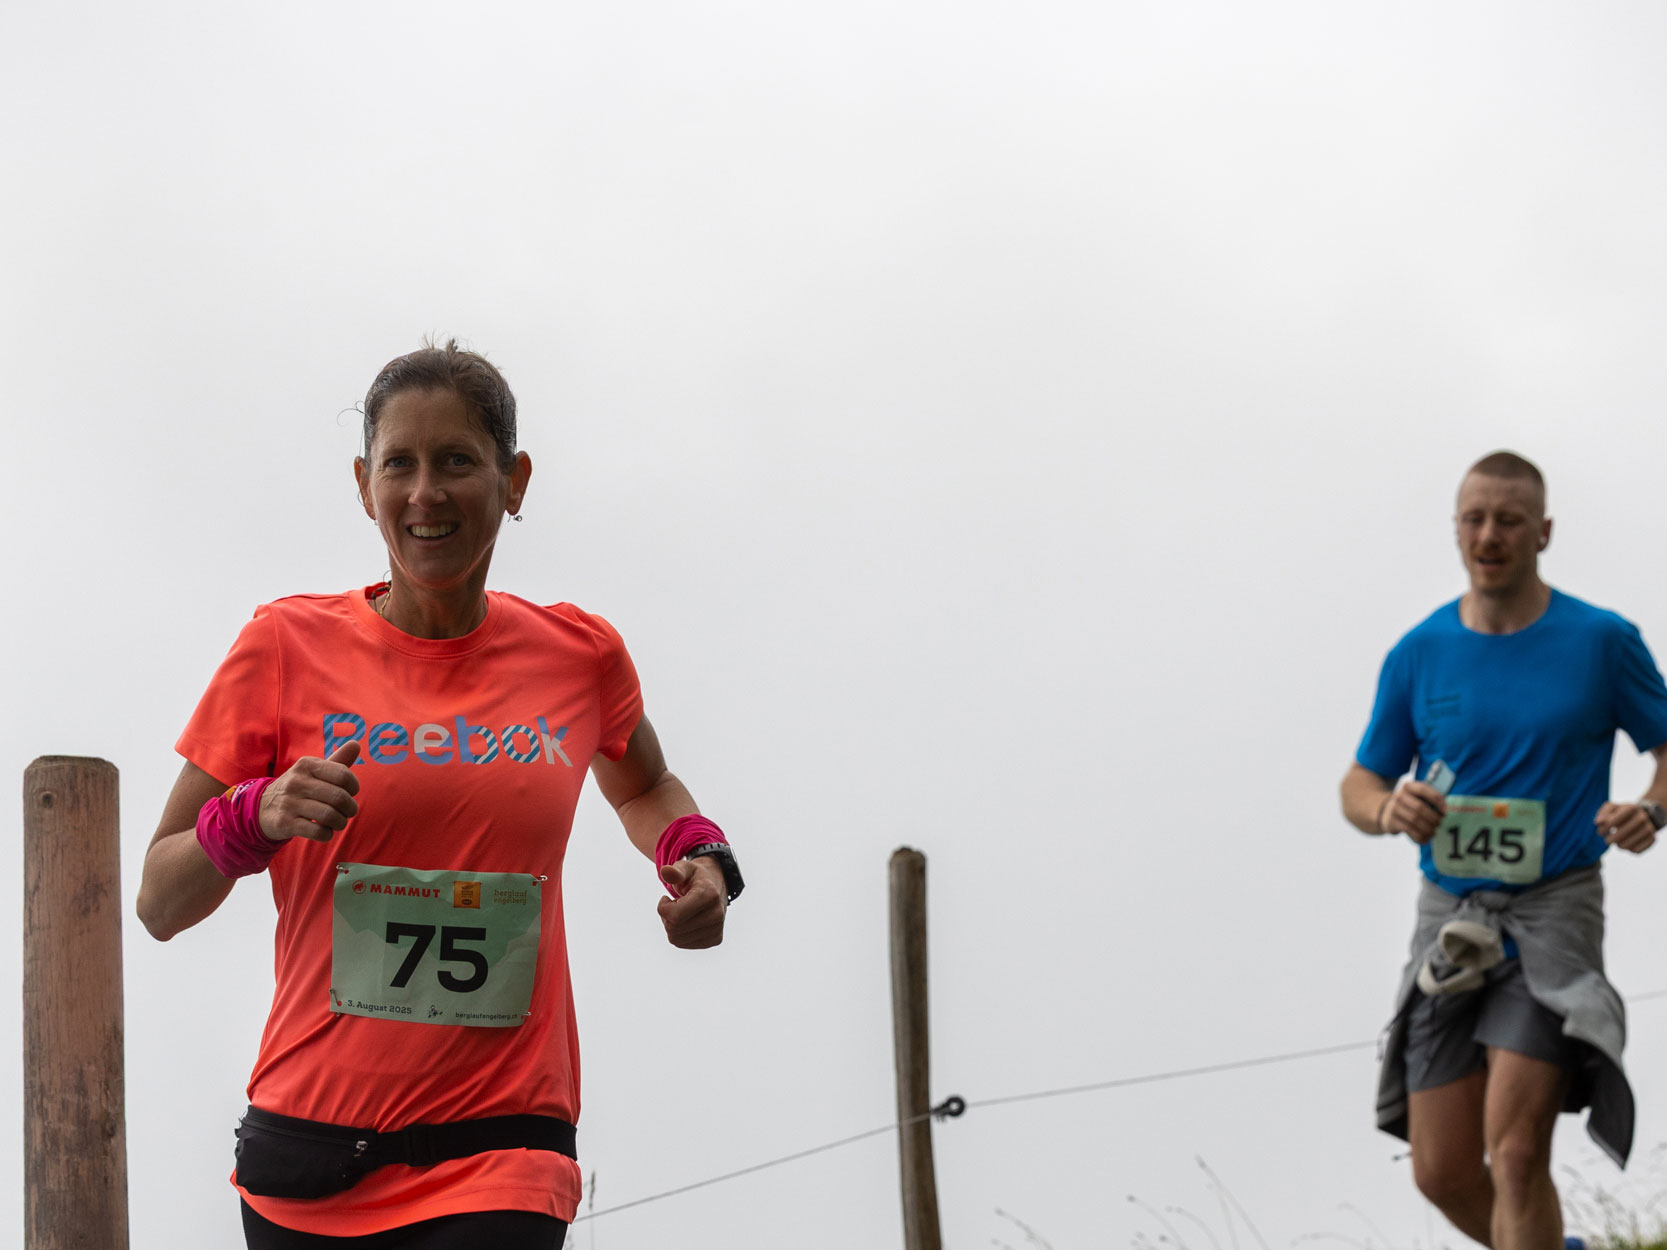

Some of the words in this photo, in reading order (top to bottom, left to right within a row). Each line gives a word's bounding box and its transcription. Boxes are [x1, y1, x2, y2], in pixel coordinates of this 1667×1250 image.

[323, 712, 573, 767] Reebok
[1447, 824, 1525, 864] 145
[370, 883, 440, 898] MAMMUT
[385, 921, 489, 993] 75
[347, 999, 355, 1008] 3.
[356, 1001, 387, 1012] August
[389, 1005, 413, 1015] 2025
